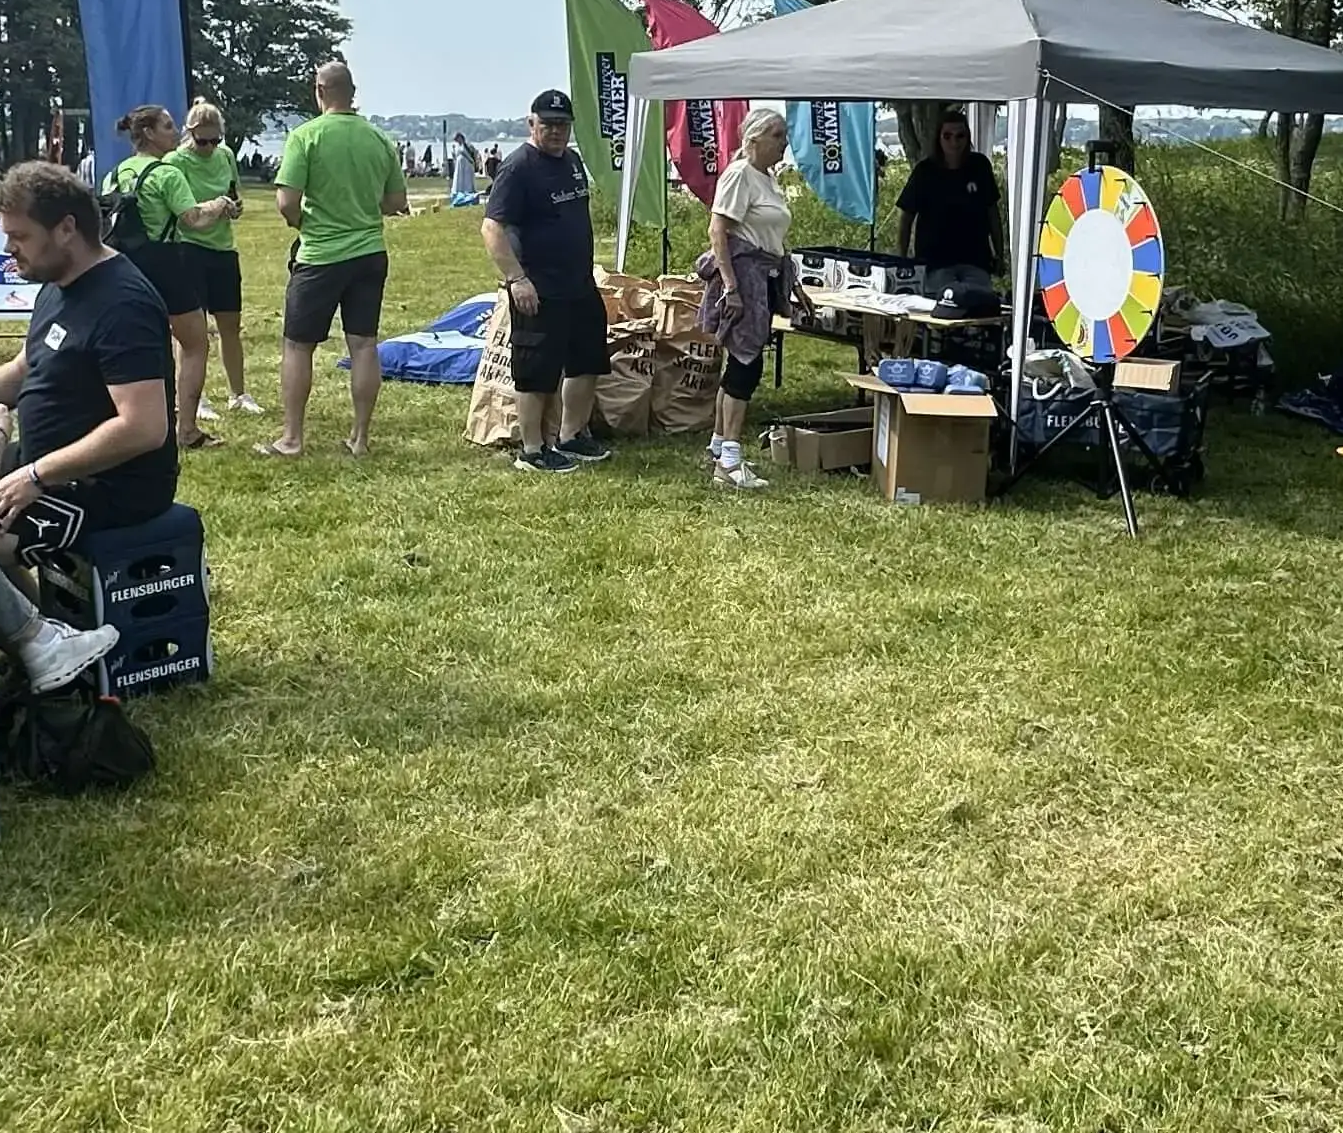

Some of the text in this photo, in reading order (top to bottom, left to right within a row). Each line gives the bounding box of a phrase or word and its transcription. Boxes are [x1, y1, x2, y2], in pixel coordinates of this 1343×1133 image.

[600, 54, 615, 136] Flensburger
[610, 74, 626, 169] SOMMER
[688, 100, 705, 145] Flensb
[813, 100, 827, 143] Flensb
[699, 100, 718, 174] SOMME
[823, 100, 840, 172] SOMME
[110, 573, 195, 604] FLENSBURGER
[116, 656, 201, 689] FLENSBURGER
